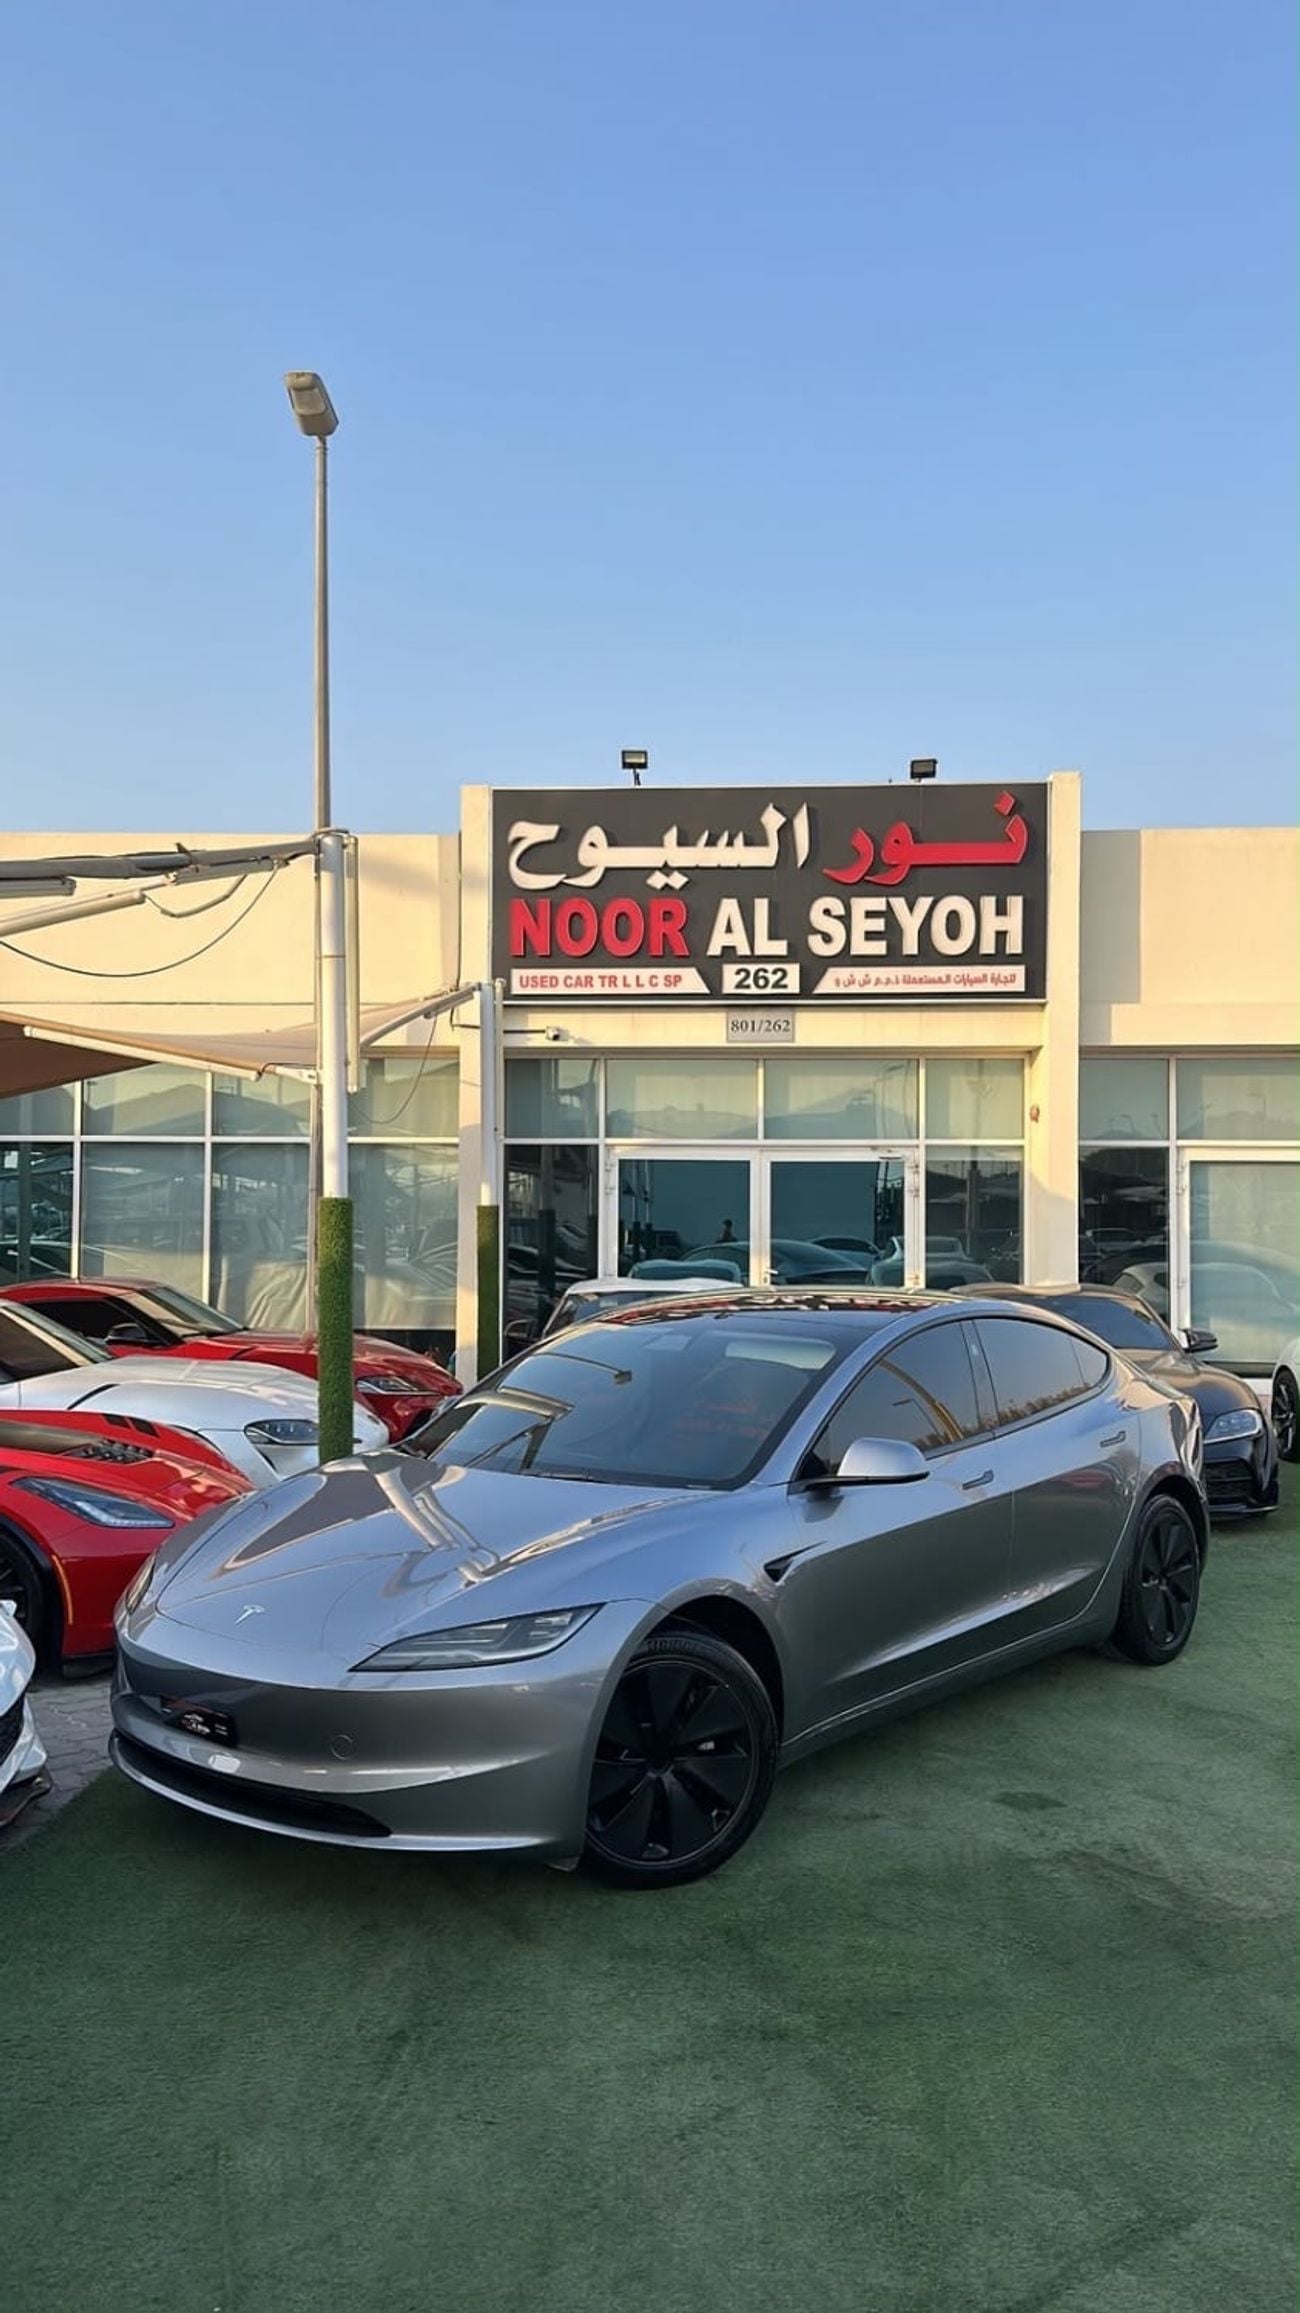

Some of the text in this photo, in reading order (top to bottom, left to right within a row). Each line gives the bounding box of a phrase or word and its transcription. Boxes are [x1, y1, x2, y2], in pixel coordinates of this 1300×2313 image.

[508, 791, 1028, 890] نور السيوح
[509, 895, 1024, 957] NOOR AL SEYOH
[519, 975, 559, 988] USED
[563, 975, 594, 988] CAR
[599, 975, 618, 988] TR
[663, 975, 683, 987] SP
[734, 967, 789, 990] 262
[902, 974, 952, 985] المستعملة
[953, 973, 988, 986] السيارات
[990, 972, 1017, 986] لتجارة
[730, 1019, 791, 1033] 801/262
